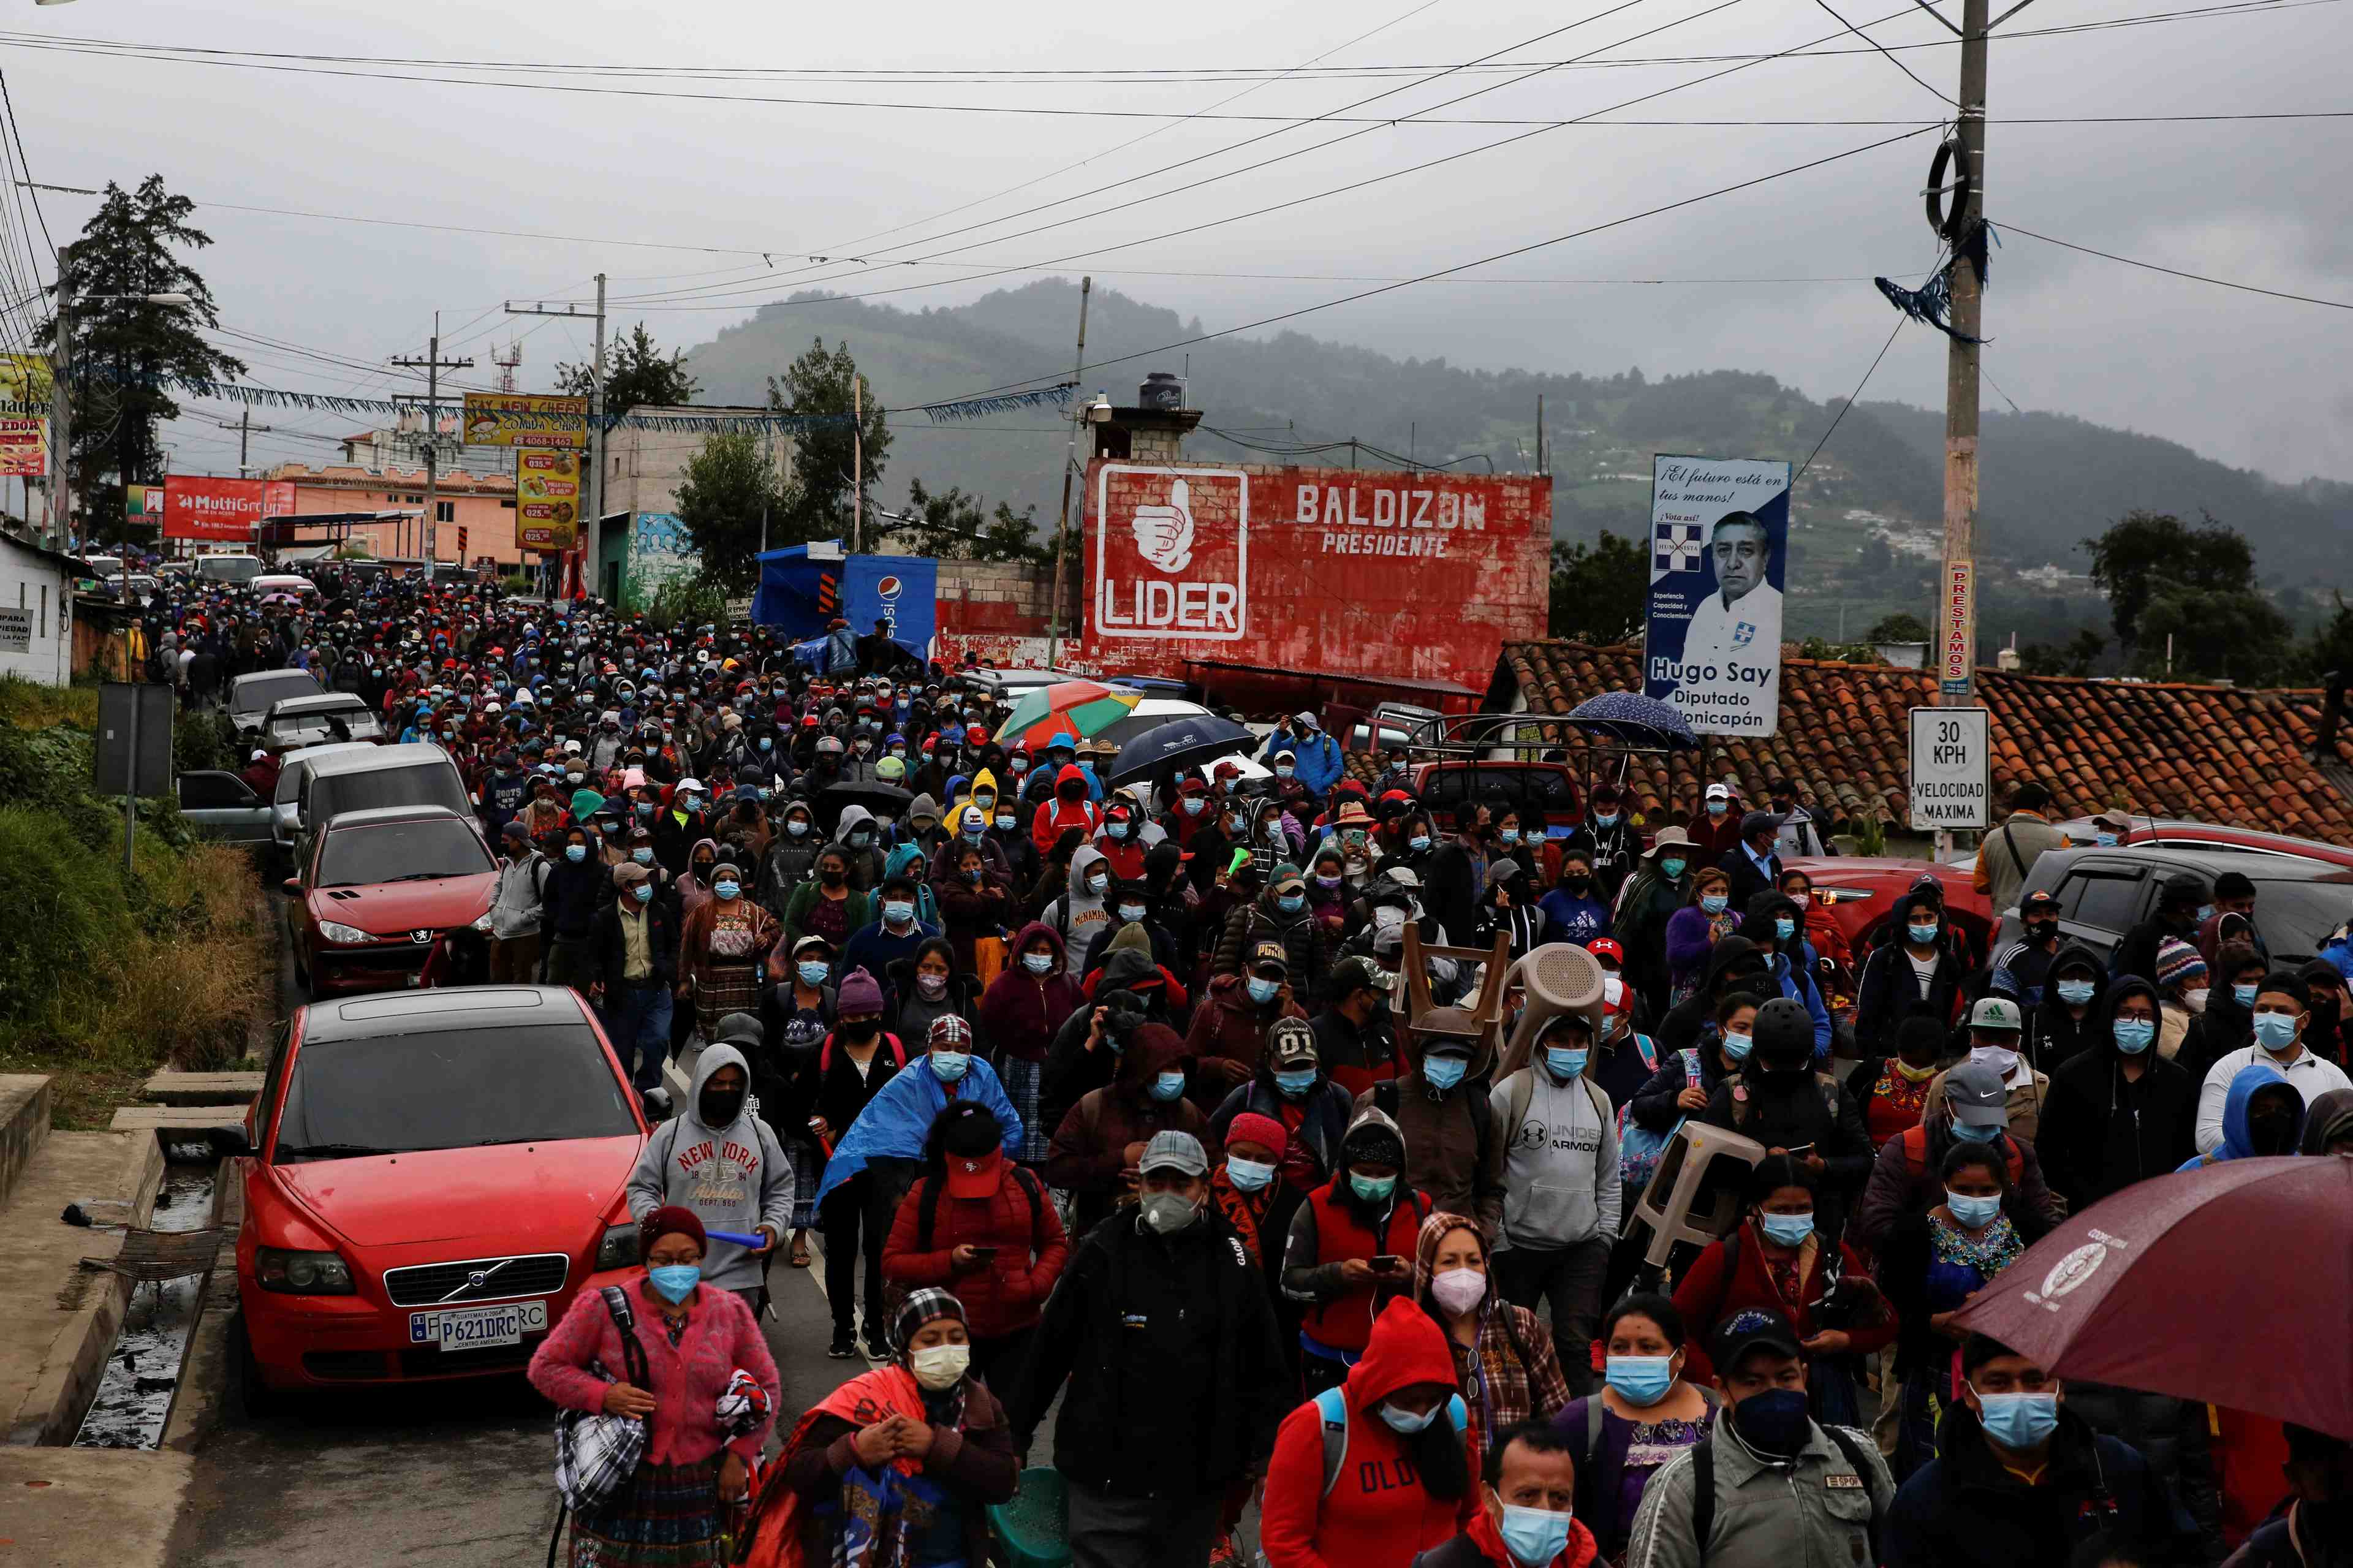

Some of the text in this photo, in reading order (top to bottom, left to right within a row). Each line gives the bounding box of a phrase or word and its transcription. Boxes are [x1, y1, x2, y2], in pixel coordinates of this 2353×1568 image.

[0, 421, 39, 430] EDOR
[1686, 468, 1732, 487] futuro
[1735, 473, 1761, 485] está
[195, 494, 281, 515] MultiGroup
[1659, 490, 1735, 503] tus manos!
[1297, 485, 1485, 530] BALDIZON
[1322, 532, 1450, 558] PRESIDENTE
[1105, 578, 1237, 629] LIDER
[881, 604, 898, 638] epsi
[1949, 572, 1966, 676] PRESTAMOS
[1653, 658, 1772, 687] Hugo Say
[1675, 689, 1750, 706] Diputado
[1938, 721, 1960, 743] 30
[1934, 745, 1966, 764] KPH
[1916, 783, 1984, 798] VELOCIDAD
[1925, 805, 1976, 819] MAXIMA
[1552, 1140, 1599, 1153] ARMOU
[677, 1141, 759, 1175] NEW YORK
[456, 1312, 487, 1321] GUATEMALA
[442, 1315, 517, 1343] P621DRC
